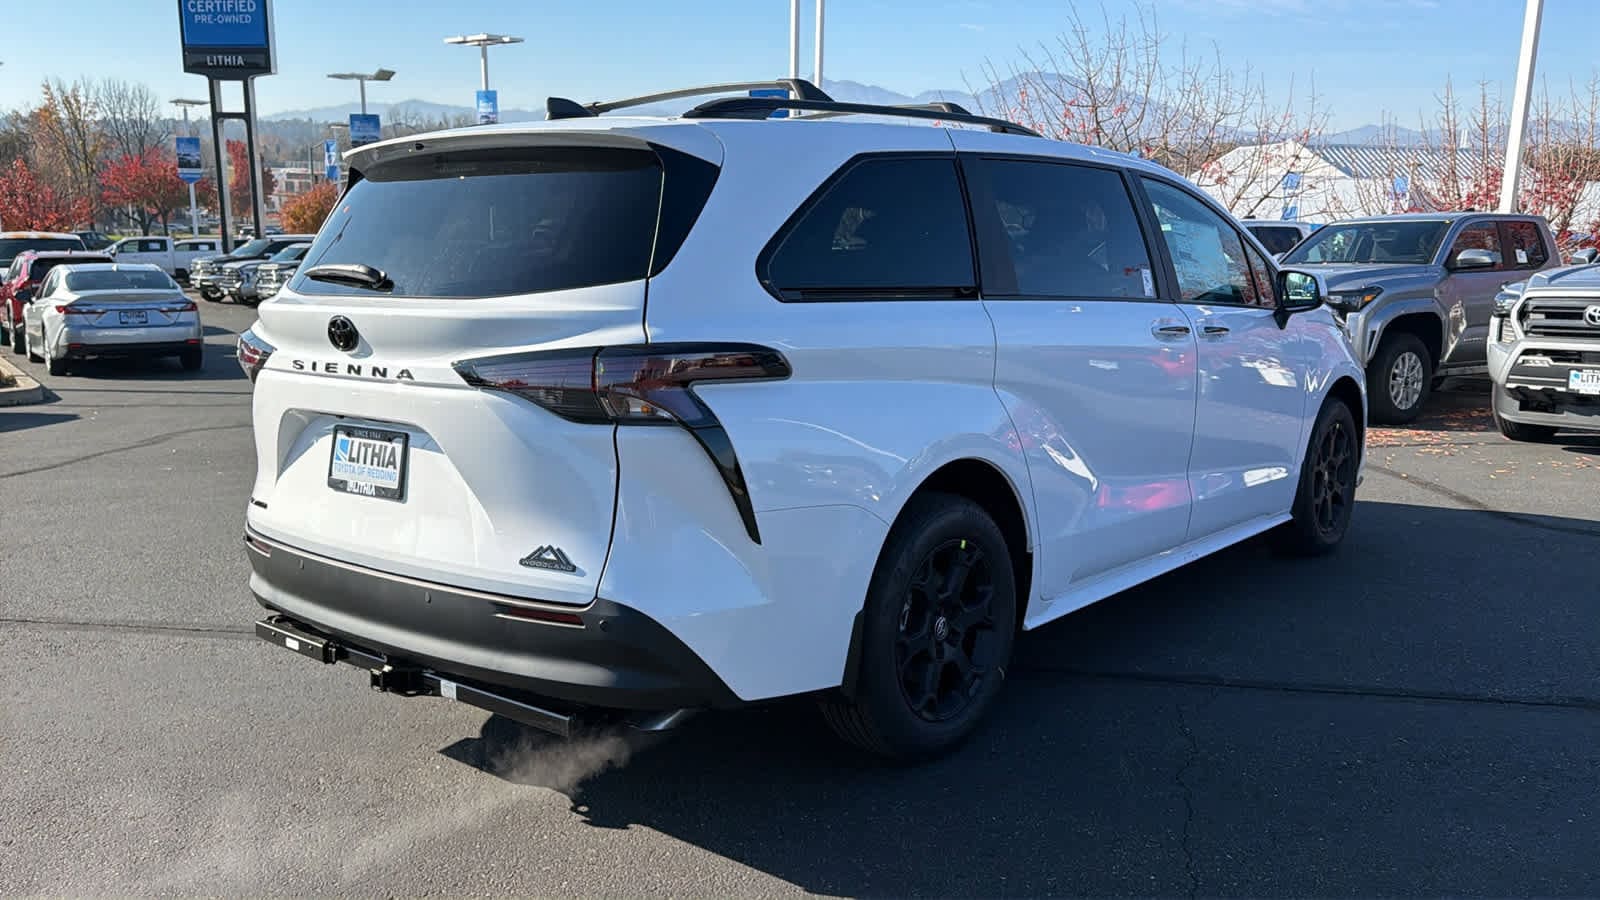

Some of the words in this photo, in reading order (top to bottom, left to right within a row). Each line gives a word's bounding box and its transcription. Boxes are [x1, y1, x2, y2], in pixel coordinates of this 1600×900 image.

[187, 0, 257, 13] CERTIFIED
[194, 14, 252, 24] PRE-OWNED
[206, 55, 245, 66] LITHIA
[291, 359, 415, 381] SIENNA
[348, 440, 397, 470] LITHIA
[334, 462, 356, 475] TOYOTA
[357, 465, 366, 476] OF
[367, 467, 397, 482] REDDING
[520, 559, 575, 572] WOODLAND
